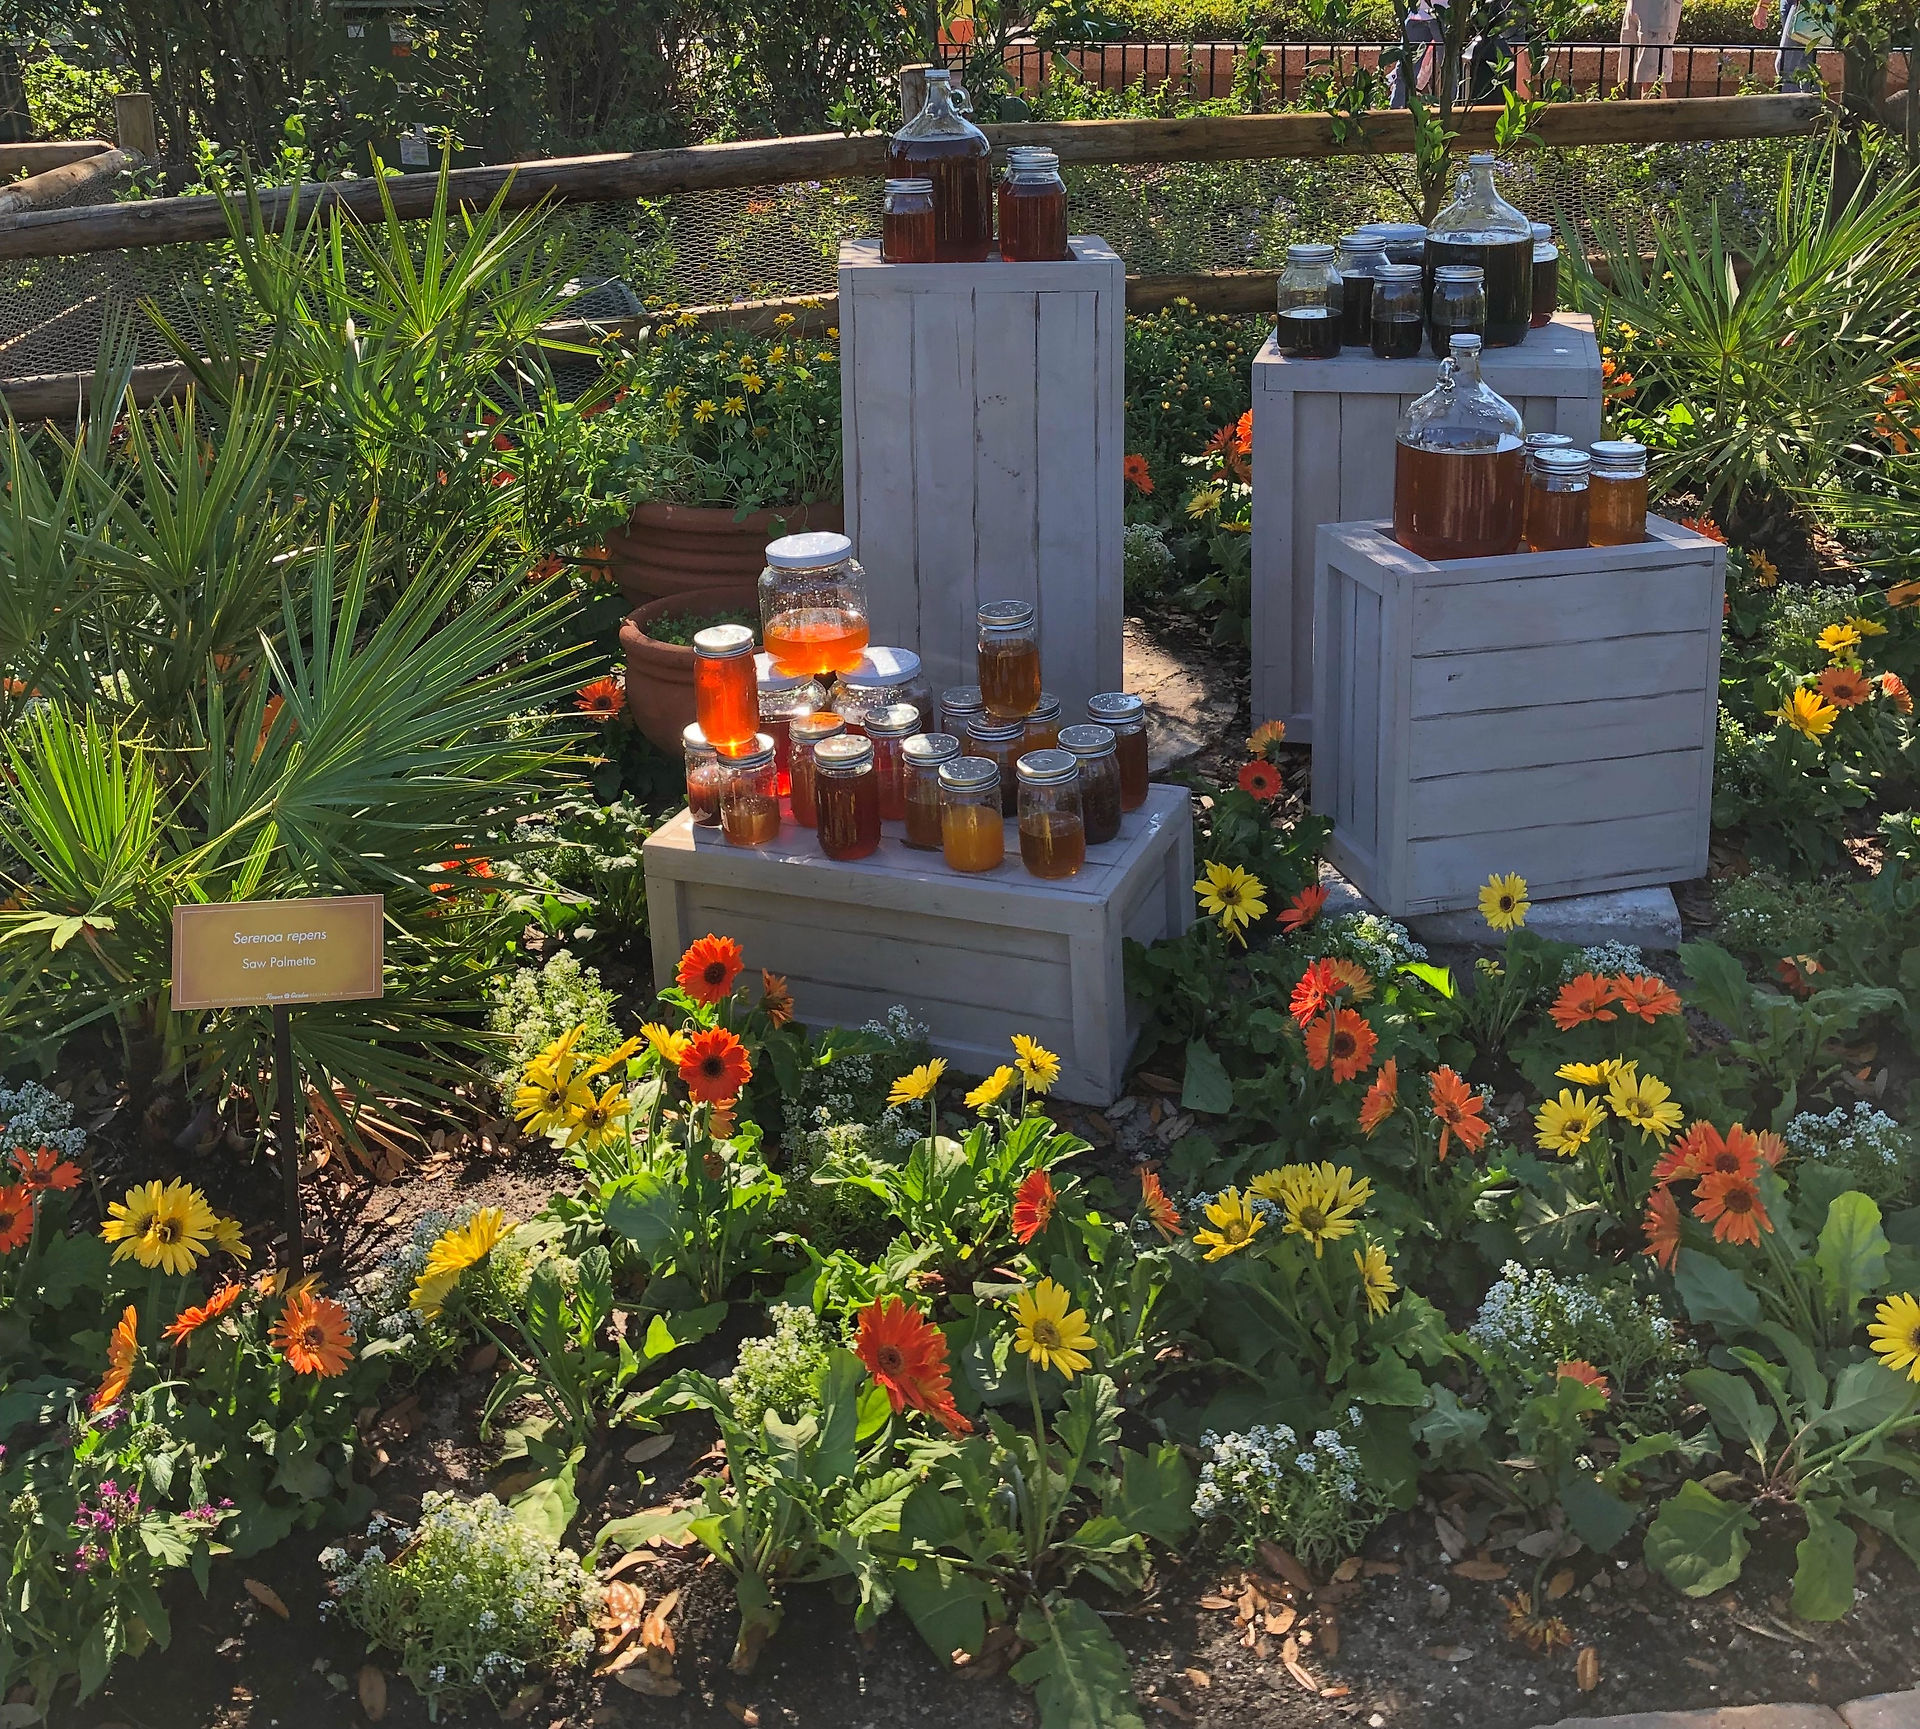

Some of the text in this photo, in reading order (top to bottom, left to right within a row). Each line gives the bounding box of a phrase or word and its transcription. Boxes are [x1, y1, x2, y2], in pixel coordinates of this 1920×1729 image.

[233, 931, 327, 945] Serenoa repens
[242, 955, 317, 969] Saw Palmetto
